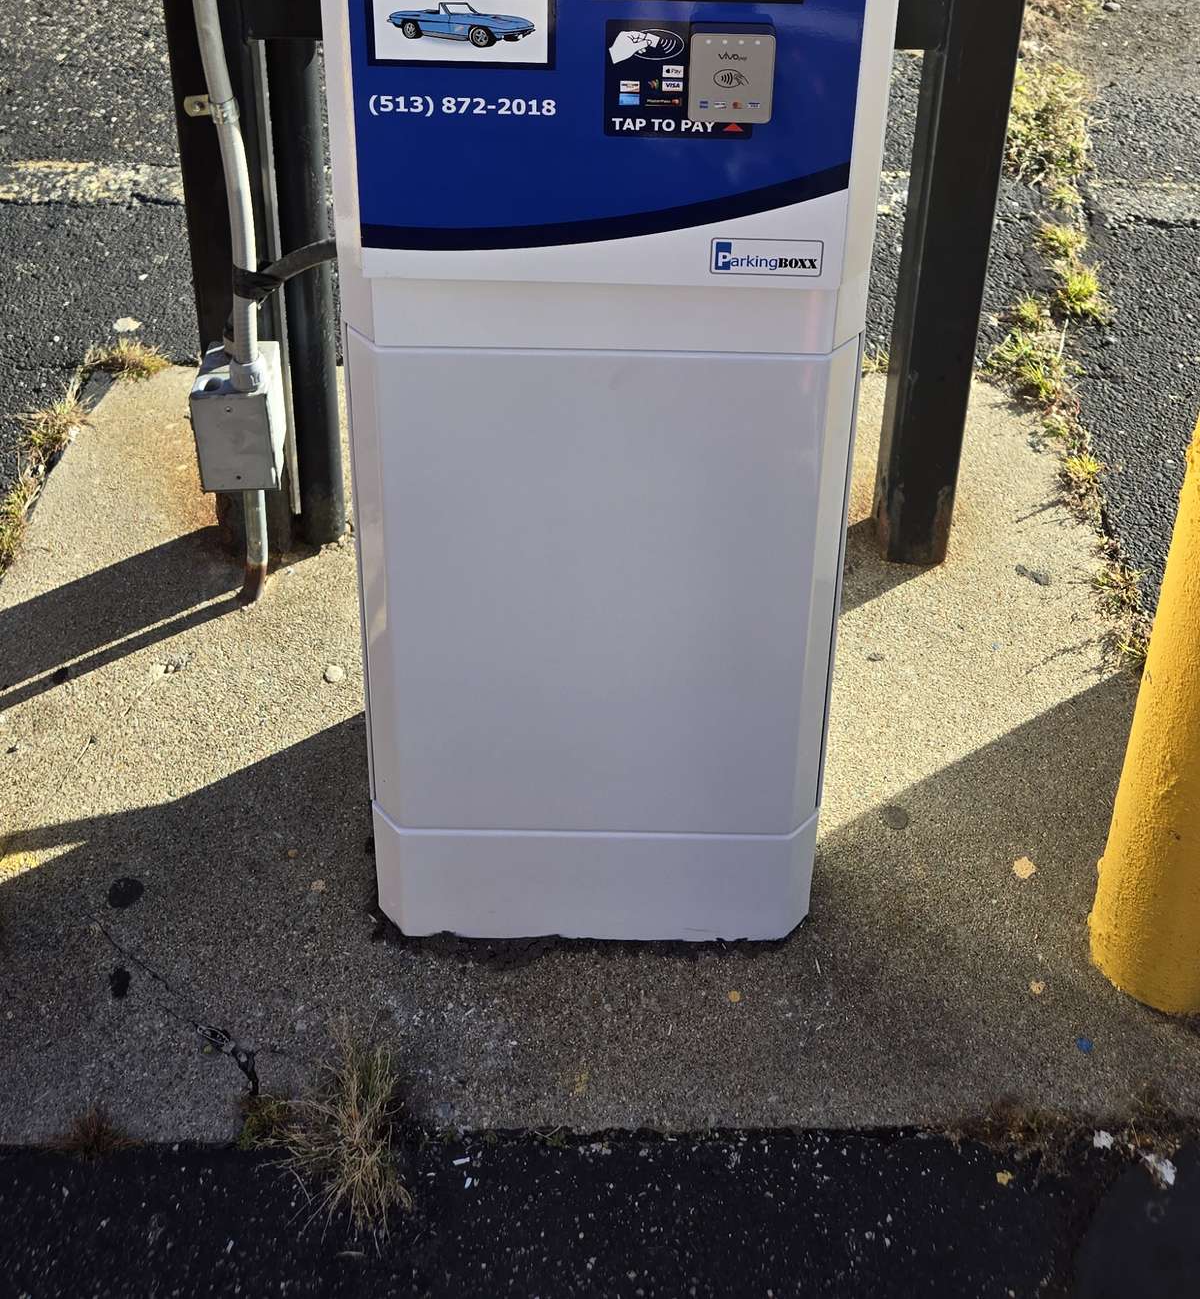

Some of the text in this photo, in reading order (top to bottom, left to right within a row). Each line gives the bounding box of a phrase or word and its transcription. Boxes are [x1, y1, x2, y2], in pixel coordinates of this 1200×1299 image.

[369, 95, 556, 117] (513) 872-2018
[612, 118, 717, 133] TAP TO PAY
[716, 249, 817, 270] ParkingBOXX
